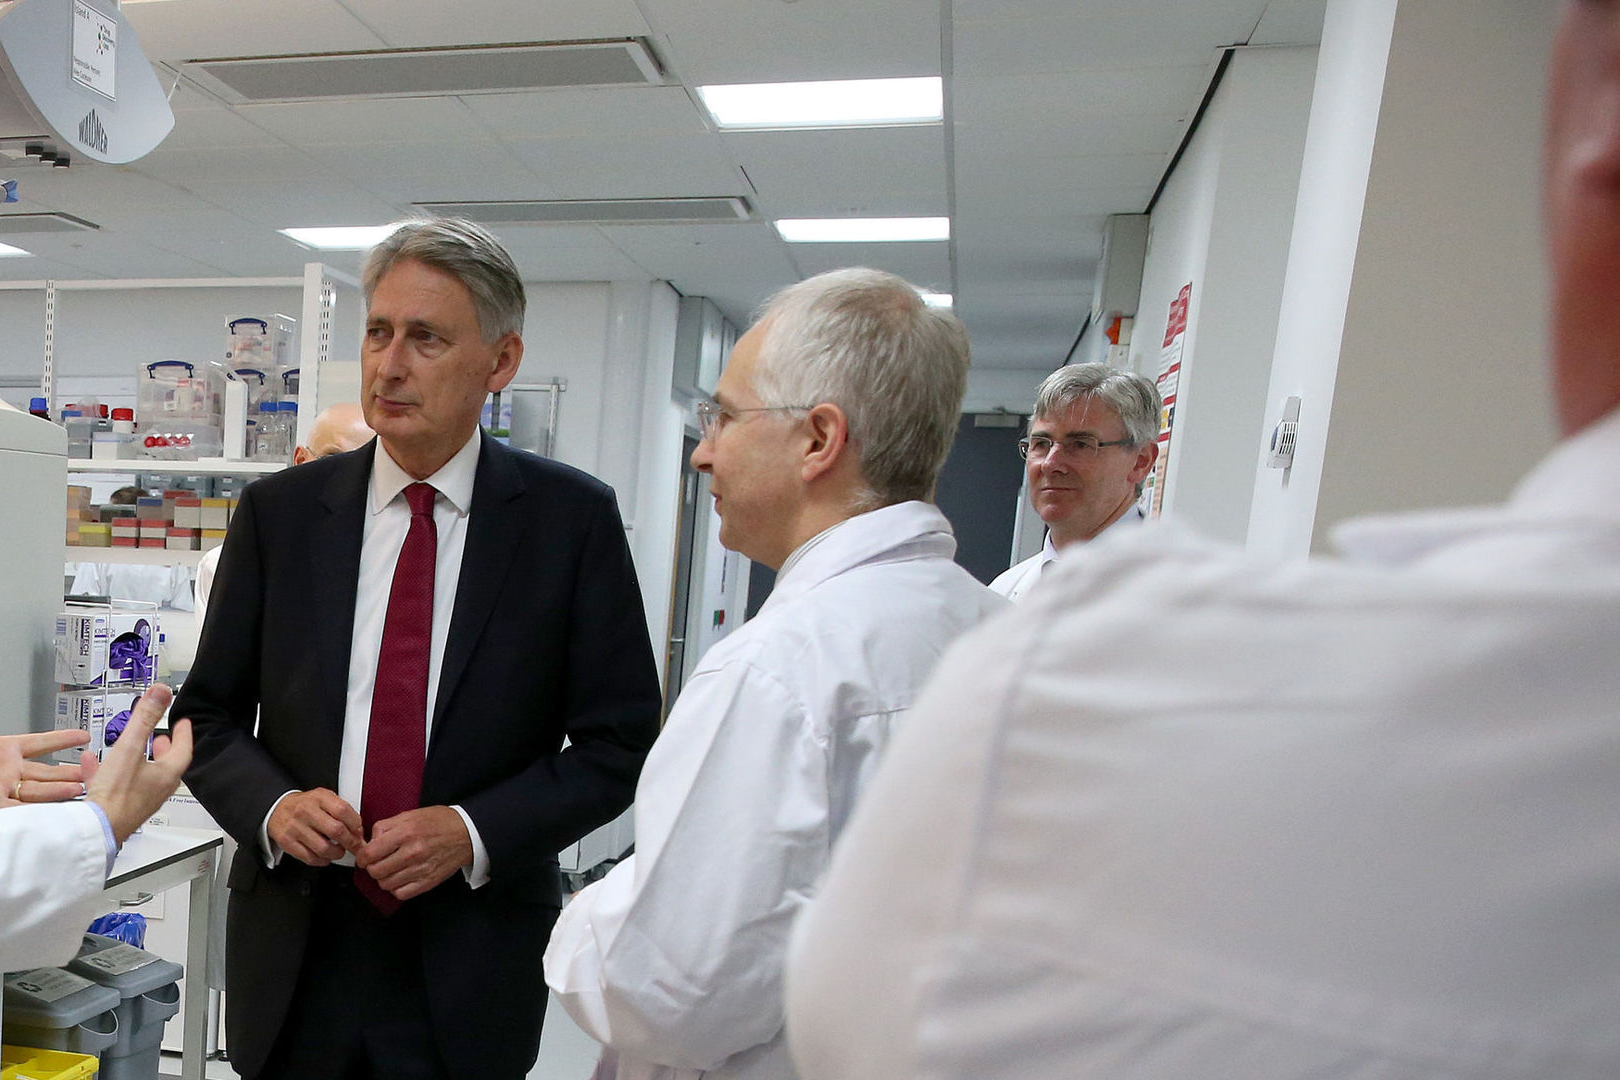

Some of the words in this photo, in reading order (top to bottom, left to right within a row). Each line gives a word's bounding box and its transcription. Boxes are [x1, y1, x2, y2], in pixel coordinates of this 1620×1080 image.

[78, 108, 108, 155] WALDNER
[83, 618, 91, 657] KIMTECH
[82, 699, 90, 731] KIMTEC
